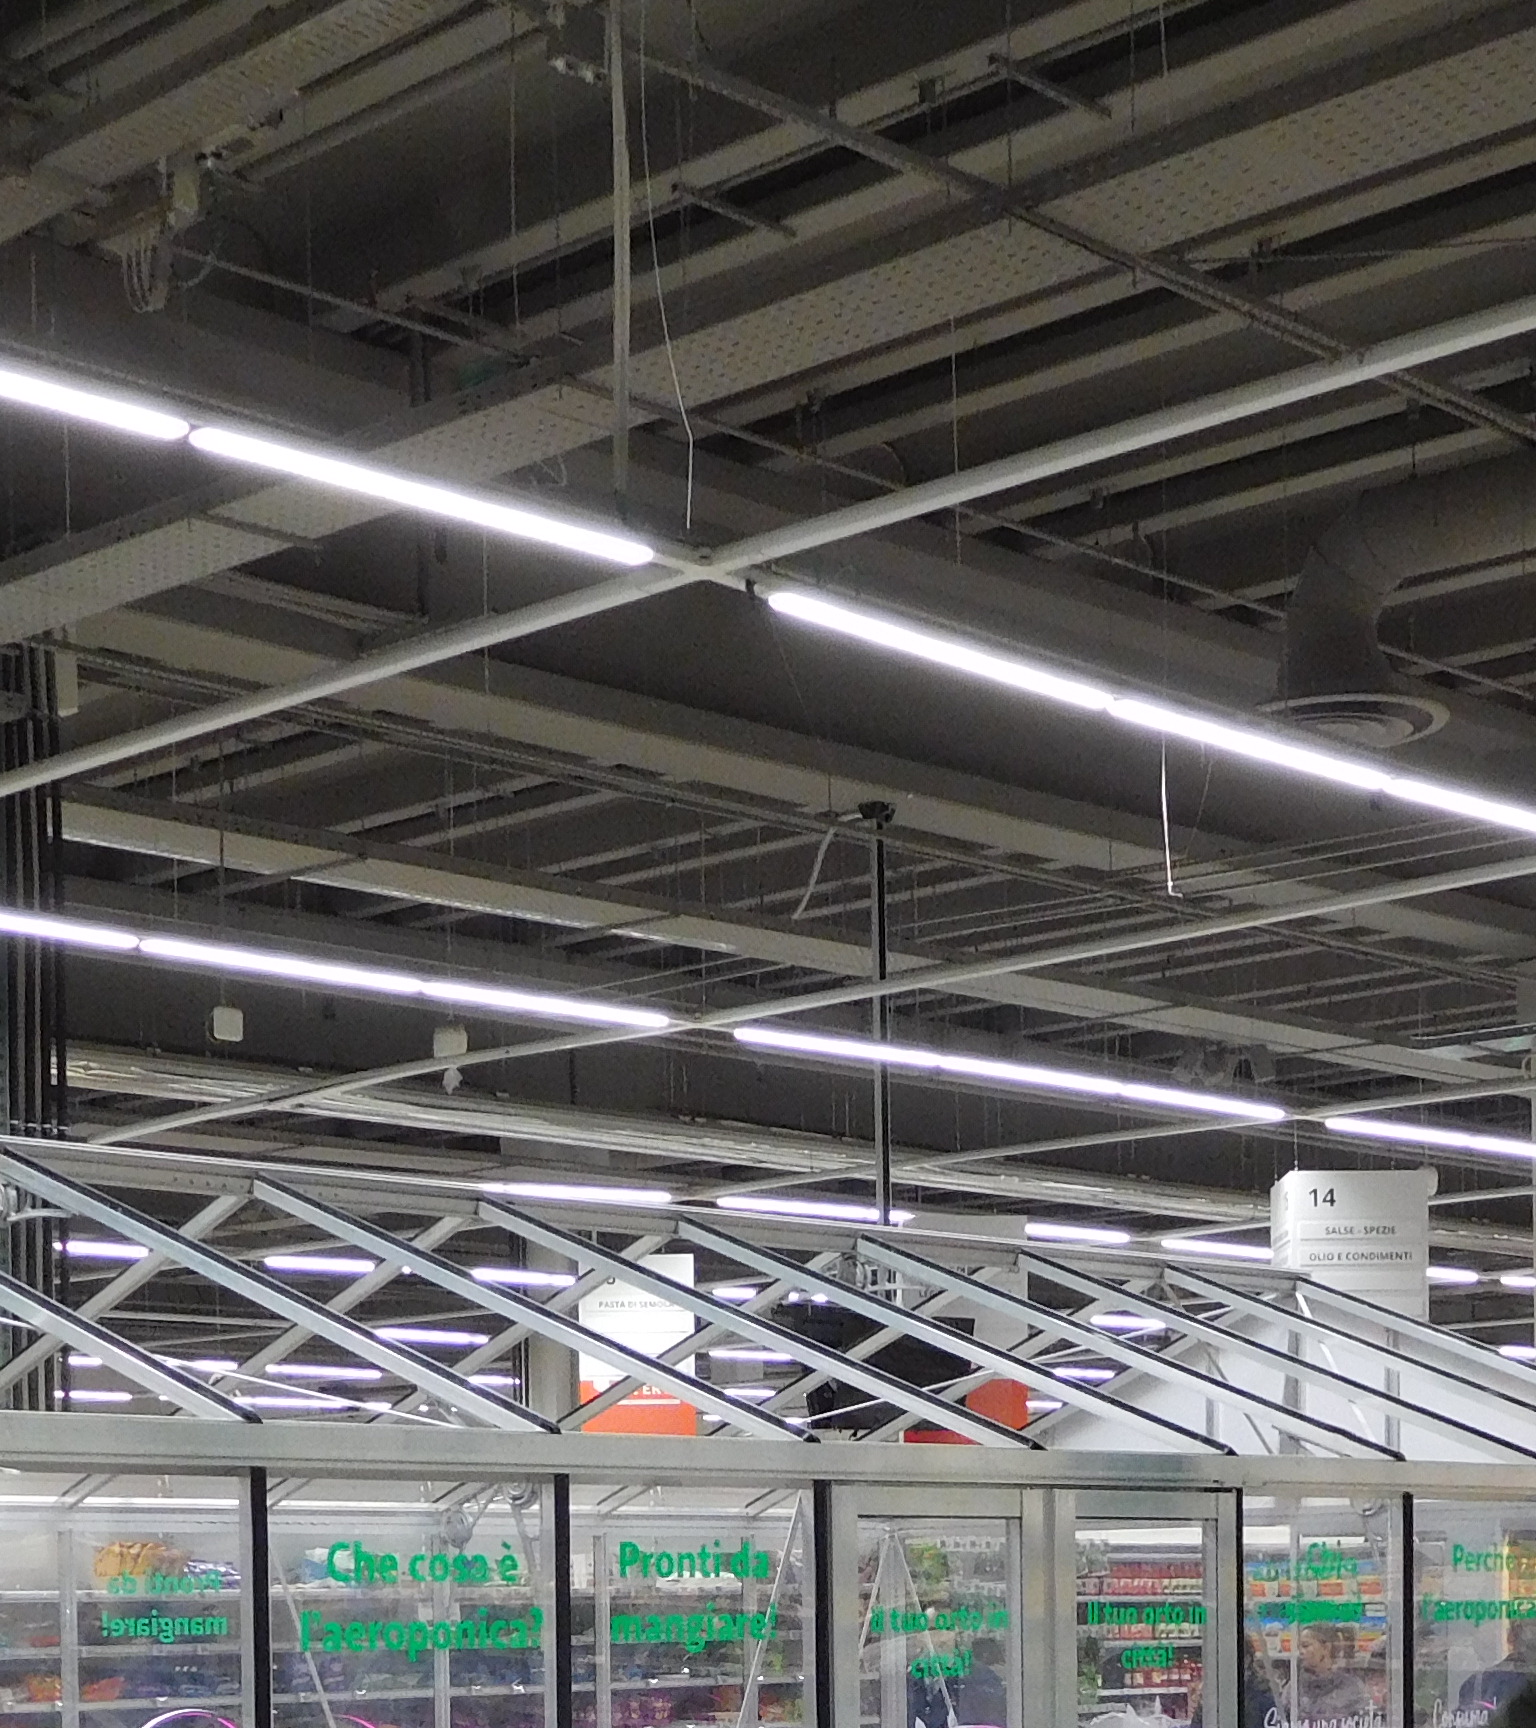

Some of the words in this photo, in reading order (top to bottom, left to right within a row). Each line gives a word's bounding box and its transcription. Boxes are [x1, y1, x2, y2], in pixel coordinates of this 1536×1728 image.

[1308, 1188, 1336, 1208] 14
[1325, 1226, 1354, 1236] SALSE
[1364, 1225, 1396, 1236] SPEZIE
[1309, 1251, 1335, 1262] OLIO
[1337, 1251, 1343, 1262] E
[1345, 1251, 1414, 1262] CONDIMENTI
[598, 1301, 626, 1309] PASTA
[628, 1301, 637, 1309] DI
[326, 1540, 399, 1584] Che
[408, 1552, 493, 1584] cosa
[499, 1540, 520, 1583] è
[618, 1540, 720, 1580] Pronti
[730, 1541, 769, 1578] da
[890, 1607, 929, 1633] tuo
[934, 1607, 984, 1633] orto
[987, 1600, 1010, 1630] in
[1102, 1602, 1136, 1625] tuo
[1142, 1602, 1186, 1626] orto
[1188, 1600, 1208, 1625] in
[300, 1607, 545, 1664] l'aeroponica?
[610, 1603, 779, 1654] mangiare!
